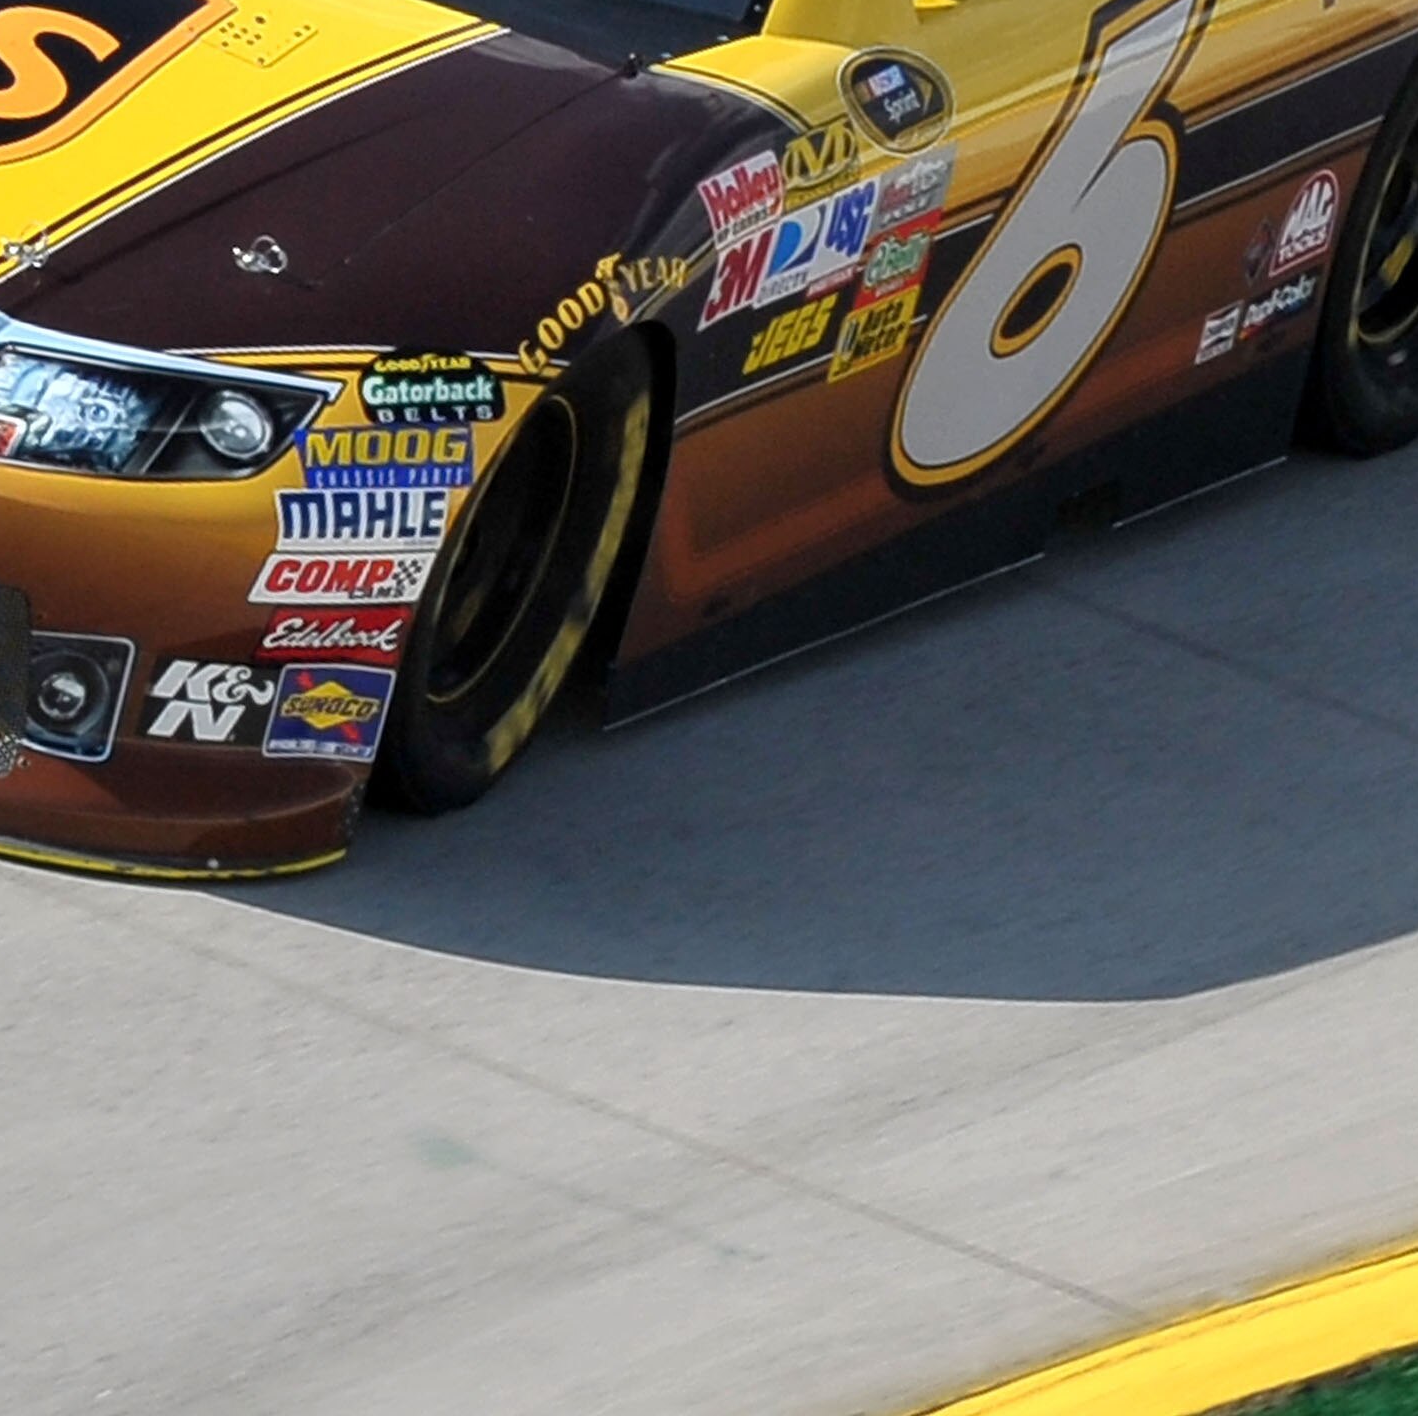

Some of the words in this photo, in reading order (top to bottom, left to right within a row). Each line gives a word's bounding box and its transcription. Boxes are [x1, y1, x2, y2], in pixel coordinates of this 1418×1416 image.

[701, 162, 780, 231] Holley
[704, 226, 775, 323] 3M
[742, 292, 839, 375] JEGS
[361, 375, 495, 405] Gatorback
[377, 405, 493, 423] BELTS
[306, 429, 467, 467] MOOG
[315, 470, 396, 488] CHASSIS
[408, 468, 464, 485] PARTS
[279, 491, 445, 538] MAHLE
[265, 559, 395, 593] COMP
[262, 617, 403, 651] Edelbrock
[282, 694, 375, 718] SUNOCO
